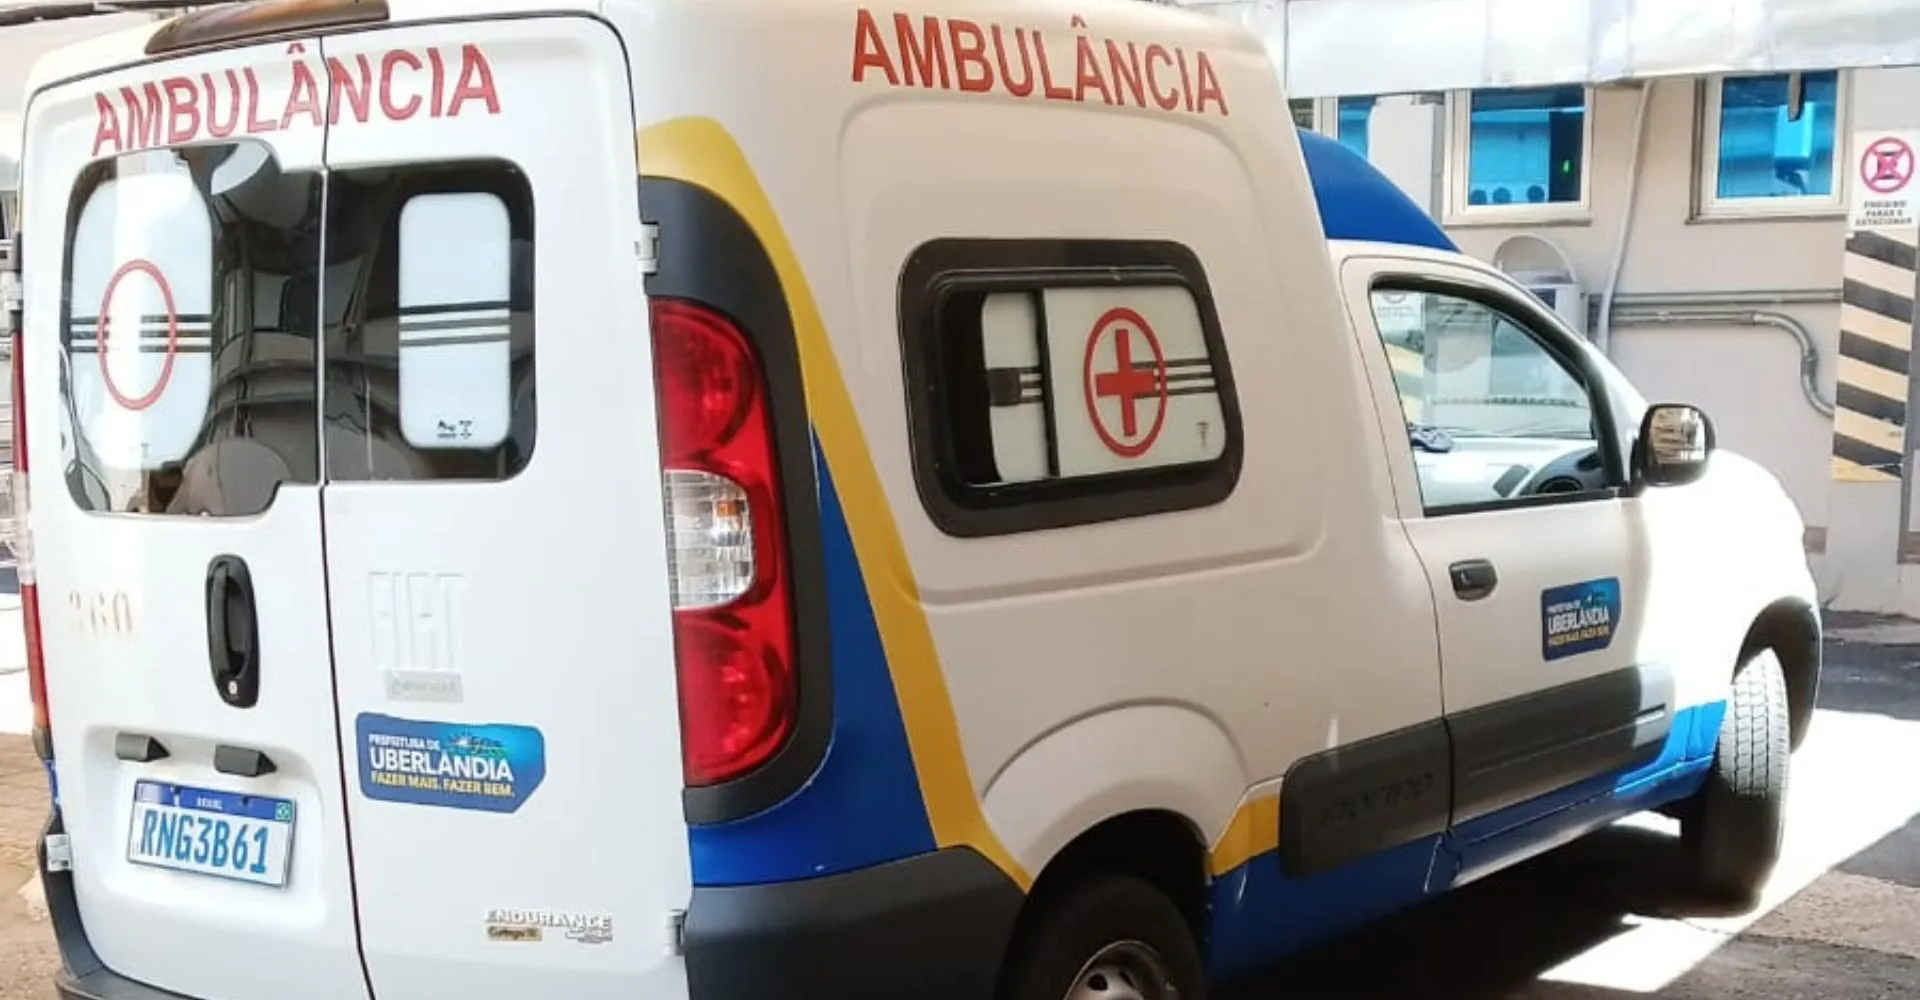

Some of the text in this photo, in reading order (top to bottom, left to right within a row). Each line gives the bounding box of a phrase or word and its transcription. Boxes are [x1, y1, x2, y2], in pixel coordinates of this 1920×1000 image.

[91, 43, 501, 157] AMBULÂNCIA
[853, 9, 1229, 116] AMBULÂNCIA
[140, 807, 269, 874] RNG3B61
